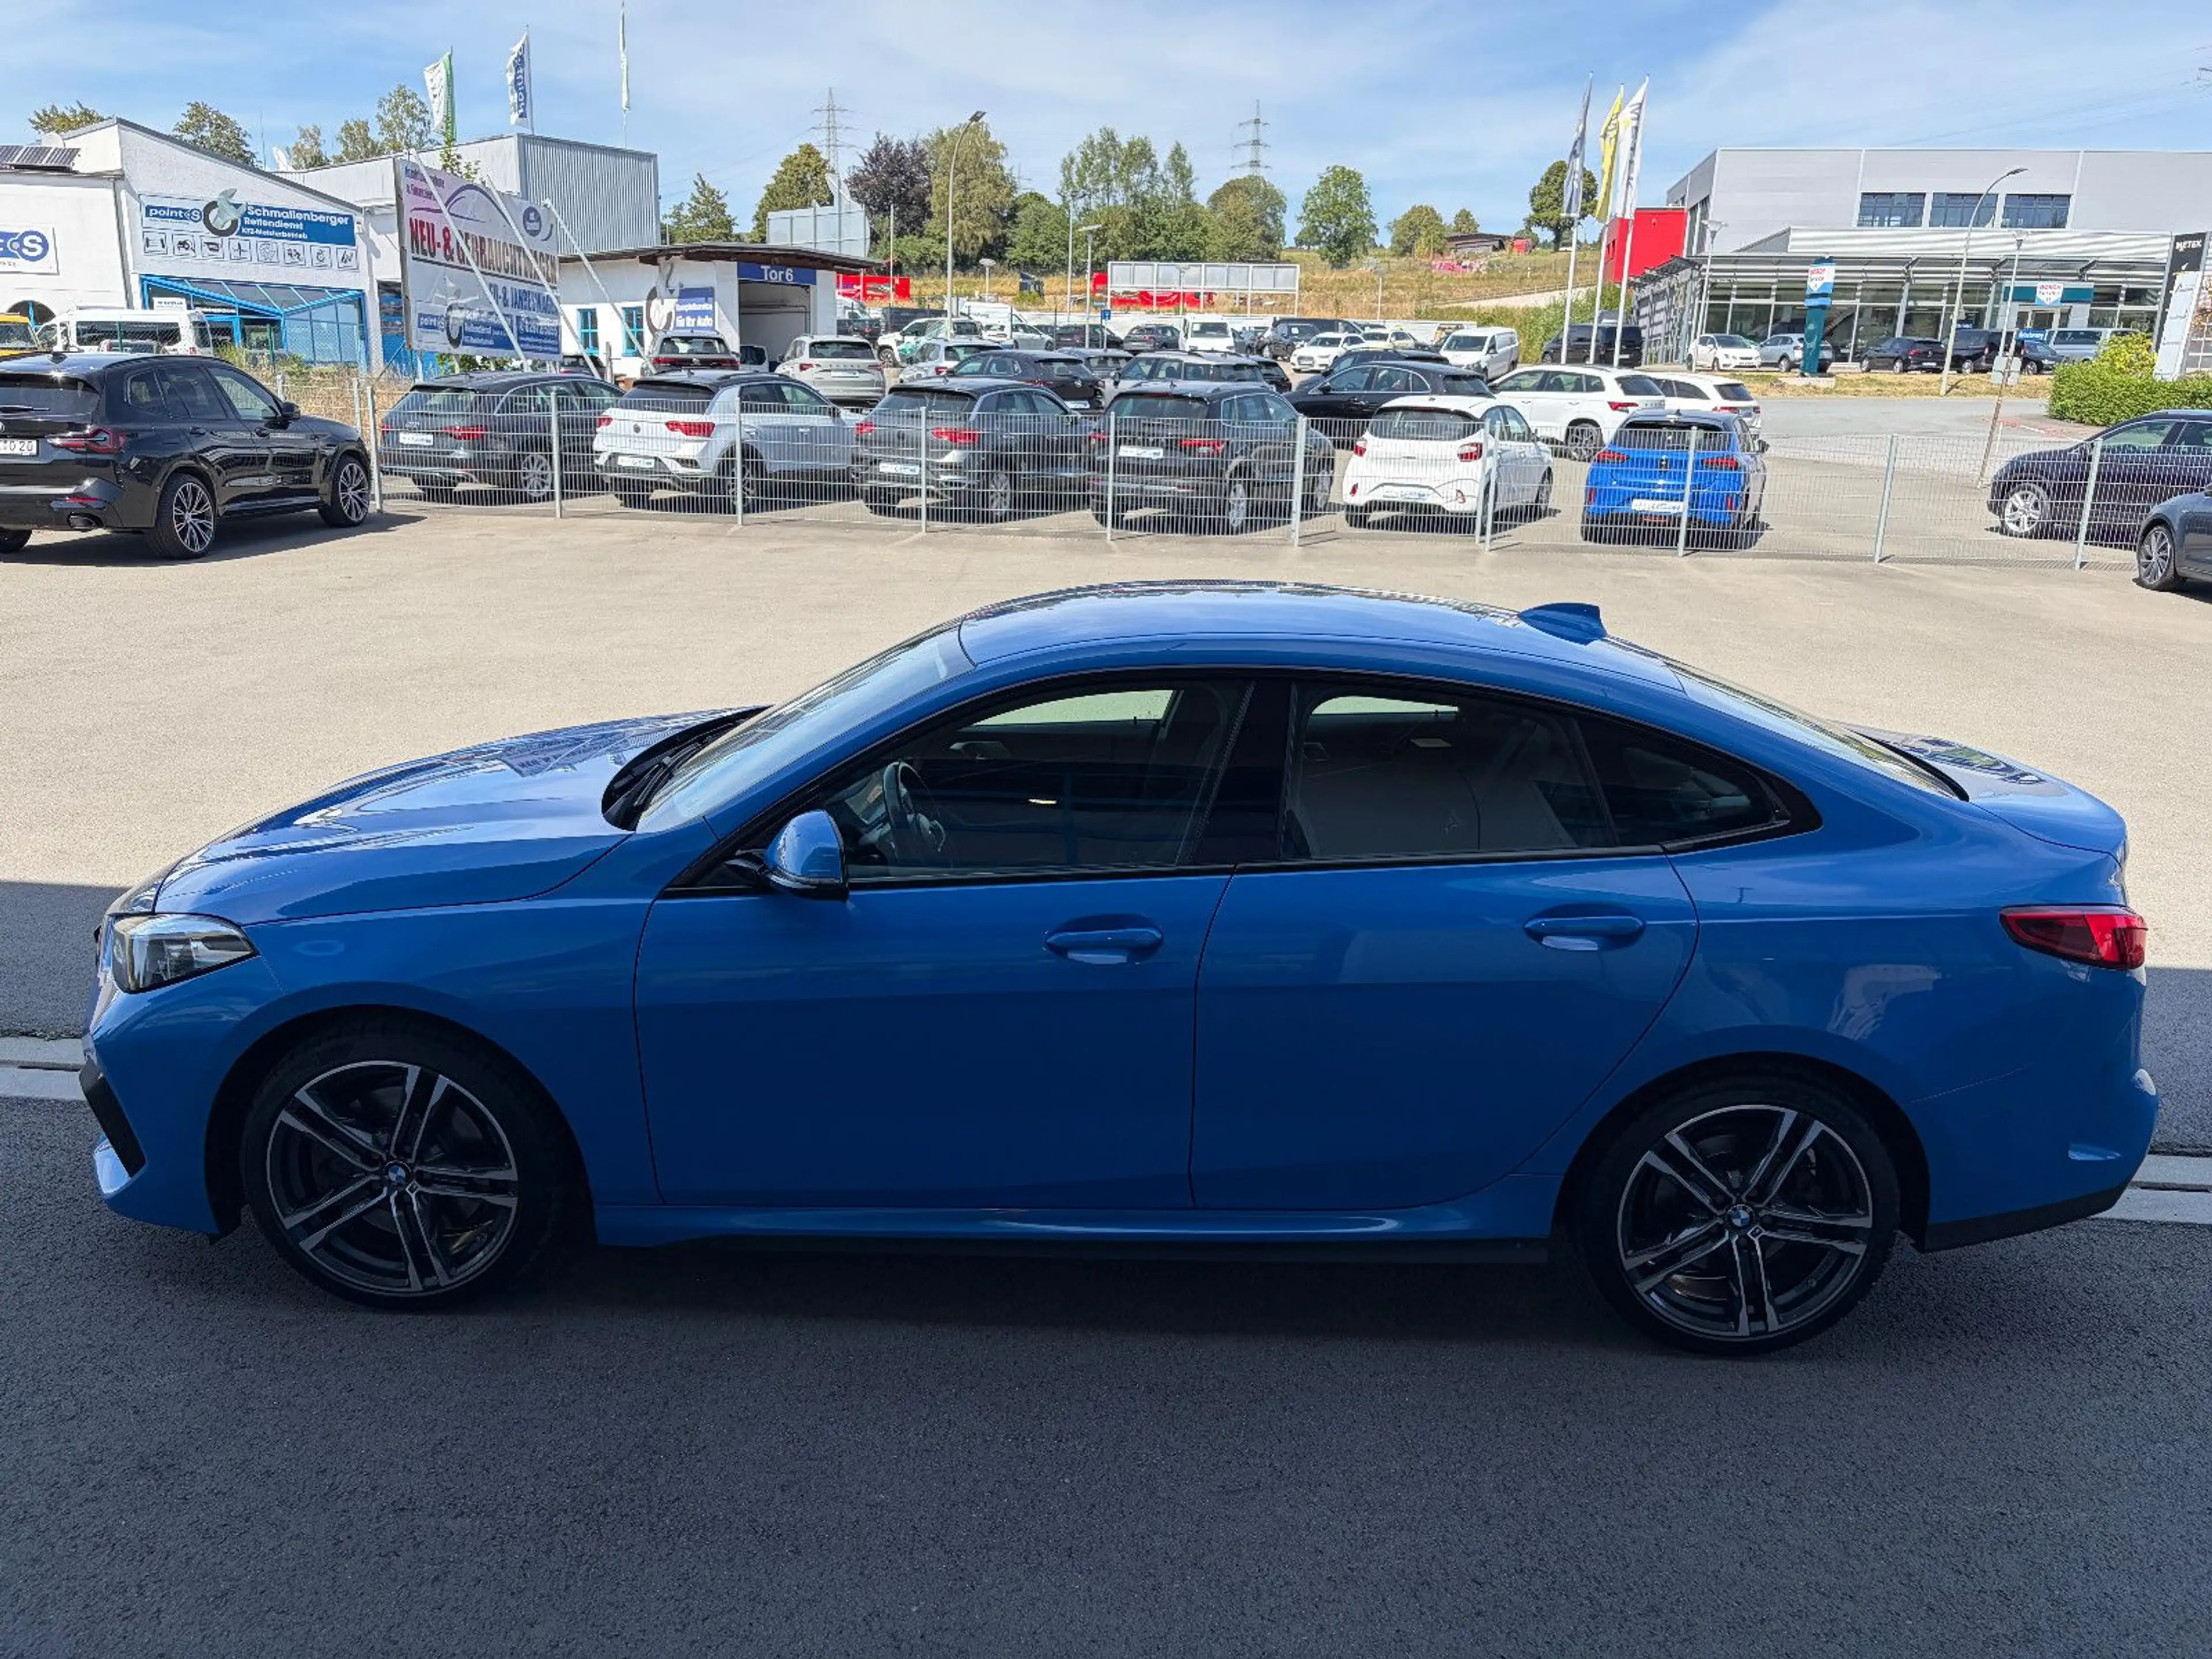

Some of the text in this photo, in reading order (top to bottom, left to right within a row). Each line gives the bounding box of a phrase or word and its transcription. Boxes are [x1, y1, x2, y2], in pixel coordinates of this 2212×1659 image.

[247, 206, 350, 226] Schmallenberger
[760, 265, 793, 282] Tor 6
